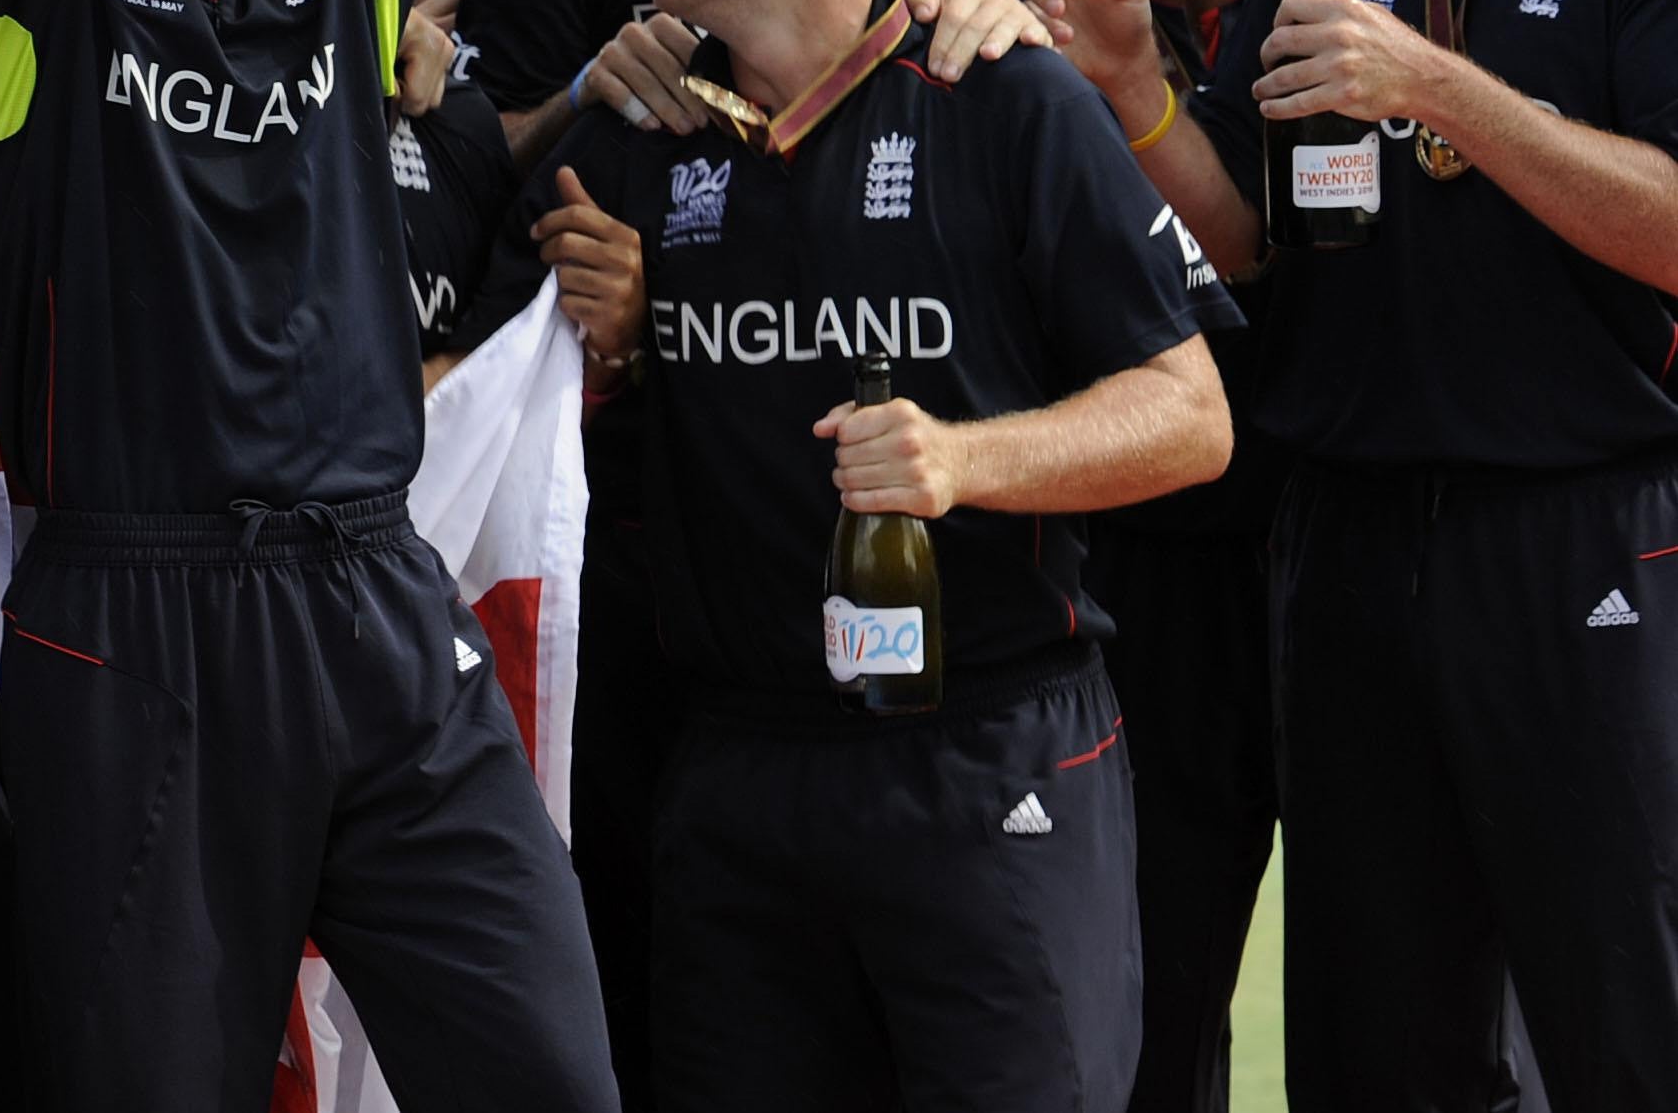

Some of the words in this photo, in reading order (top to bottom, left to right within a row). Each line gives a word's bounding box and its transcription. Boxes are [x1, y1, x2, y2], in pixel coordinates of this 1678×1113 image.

[1327, 152, 1374, 169] WORLD
[1298, 169, 1374, 186] TWENTY20
[1299, 188, 1324, 197] WEST
[1326, 187, 1355, 197] INDIES
[650, 296, 954, 365] ENGLAND
[1586, 611, 1640, 627] adidas
